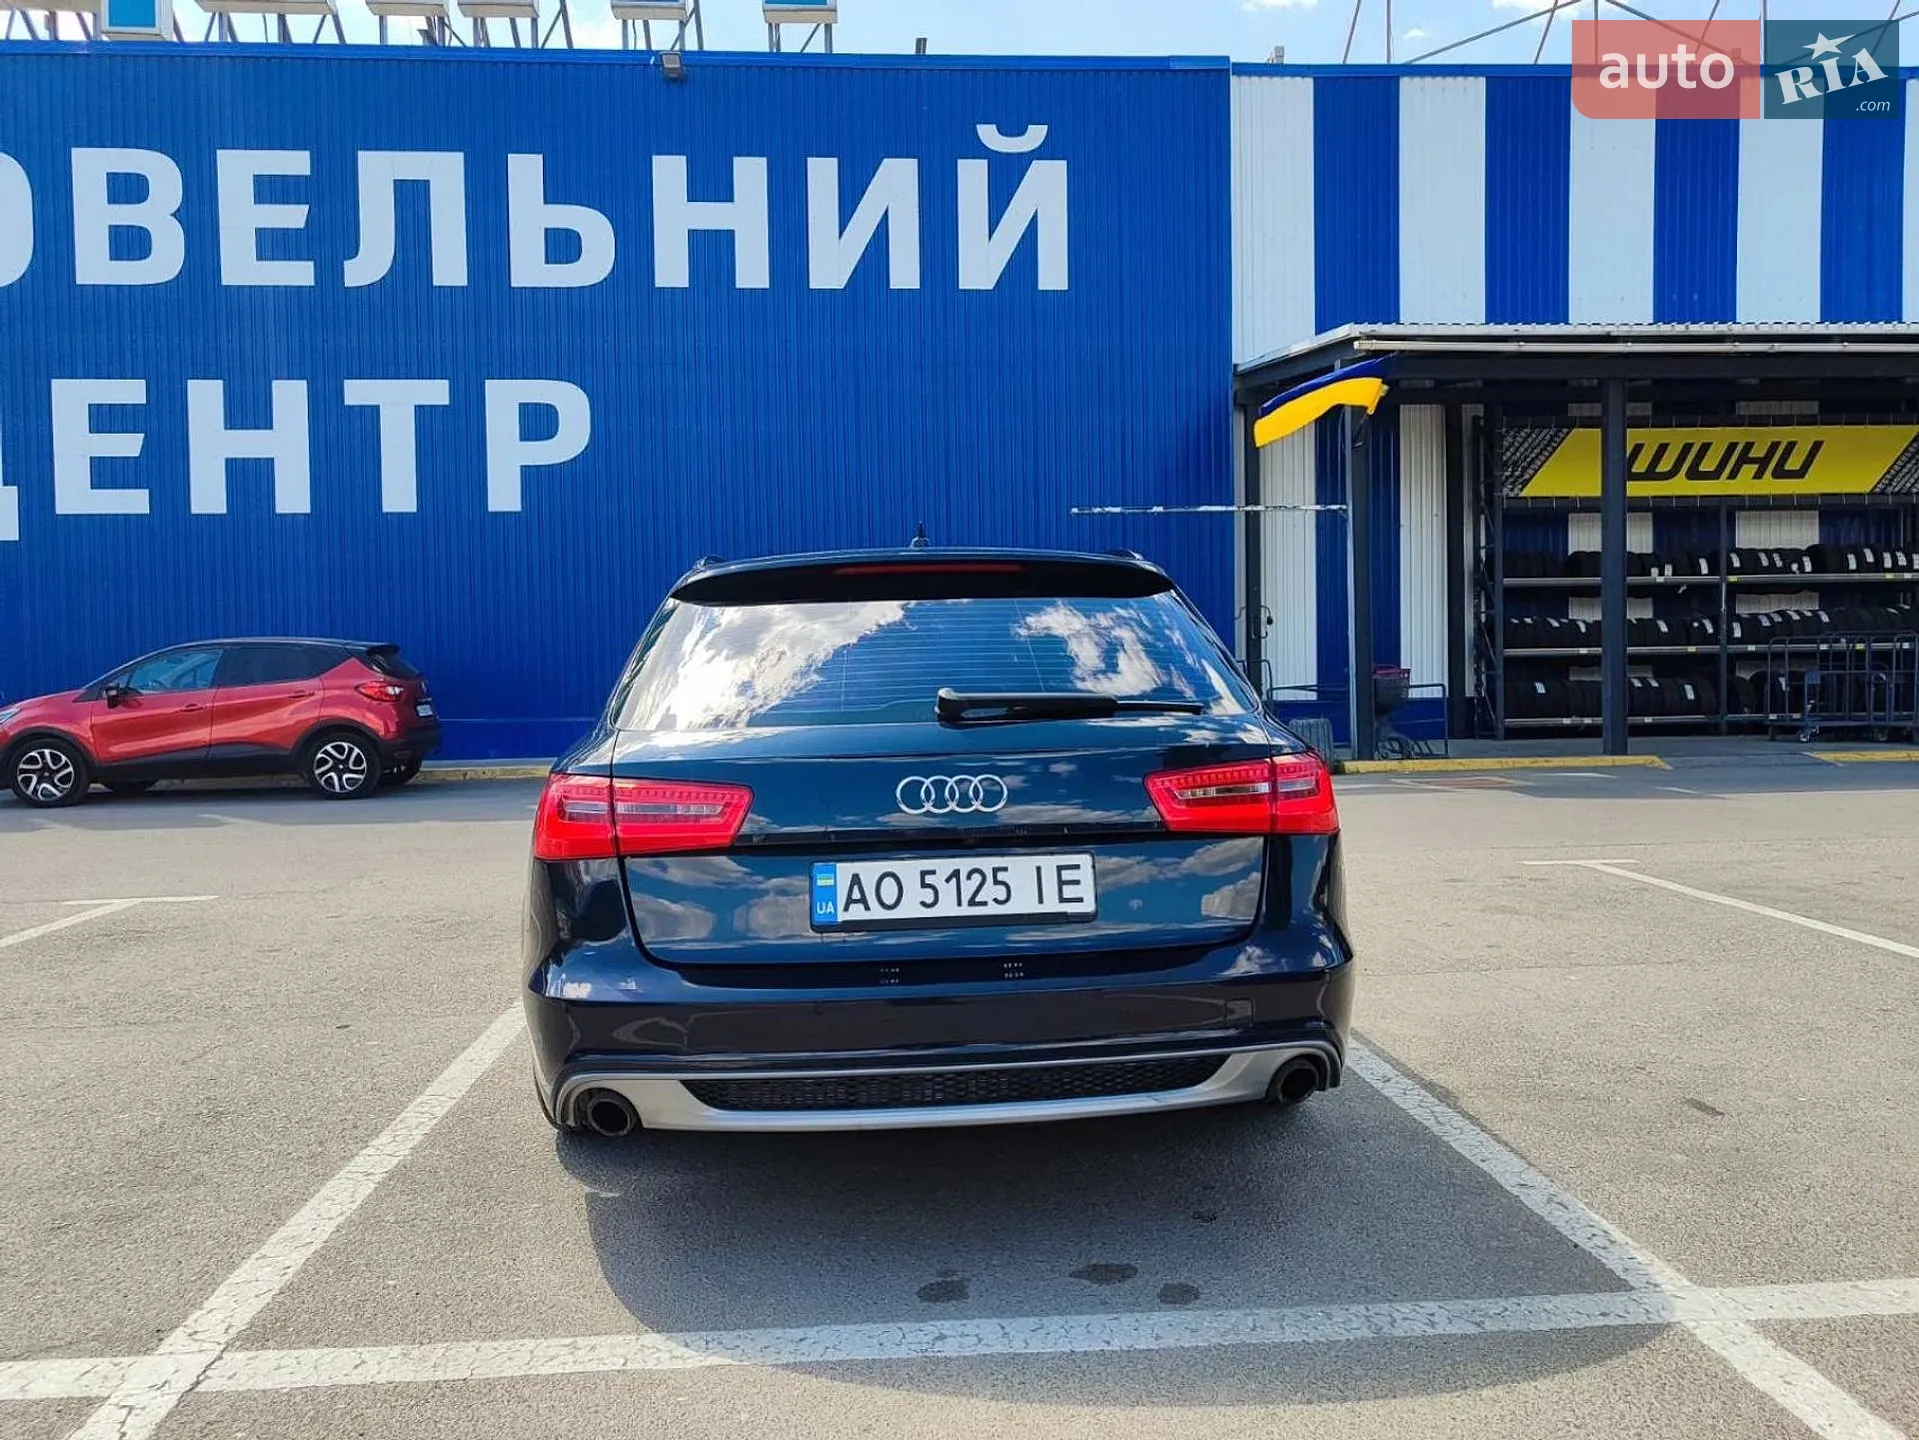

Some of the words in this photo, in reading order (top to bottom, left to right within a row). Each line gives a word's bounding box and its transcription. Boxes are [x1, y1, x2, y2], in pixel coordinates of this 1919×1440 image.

[0, 378, 592, 541] ЕНТР
[816, 902, 835, 914] UA
[843, 871, 904, 912] AO
[919, 866, 1012, 909] 5125
[1035, 863, 1084, 904] IE
